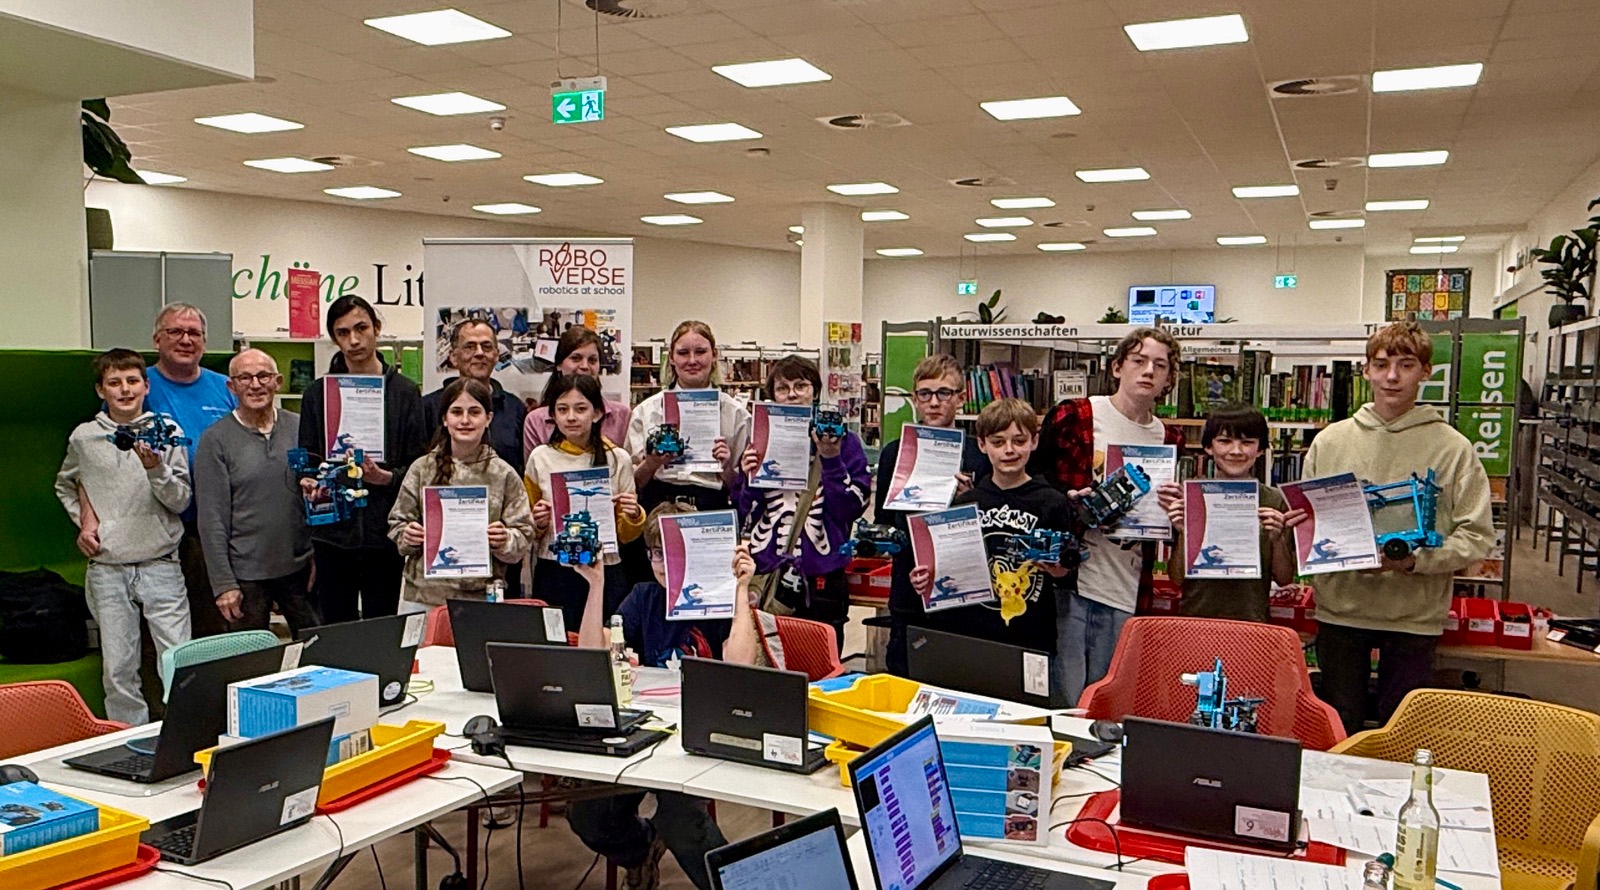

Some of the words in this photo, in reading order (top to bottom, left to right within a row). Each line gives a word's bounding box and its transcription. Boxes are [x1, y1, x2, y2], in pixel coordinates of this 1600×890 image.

[551, 268, 625, 285] VERSE
[539, 287, 578, 295] robotics
[581, 287, 591, 295] at
[594, 287, 625, 295] school
[941, 325, 1078, 337] Naturwissenschaften
[1161, 325, 1203, 336] Natur
[1181, 346, 1232, 355] Allgemeines
[1474, 350, 1506, 459] Reisen
[701, 526, 733, 534] Zertifikat
[732, 709, 752, 718] ASUS
[1193, 777, 1221, 788] ASUS
